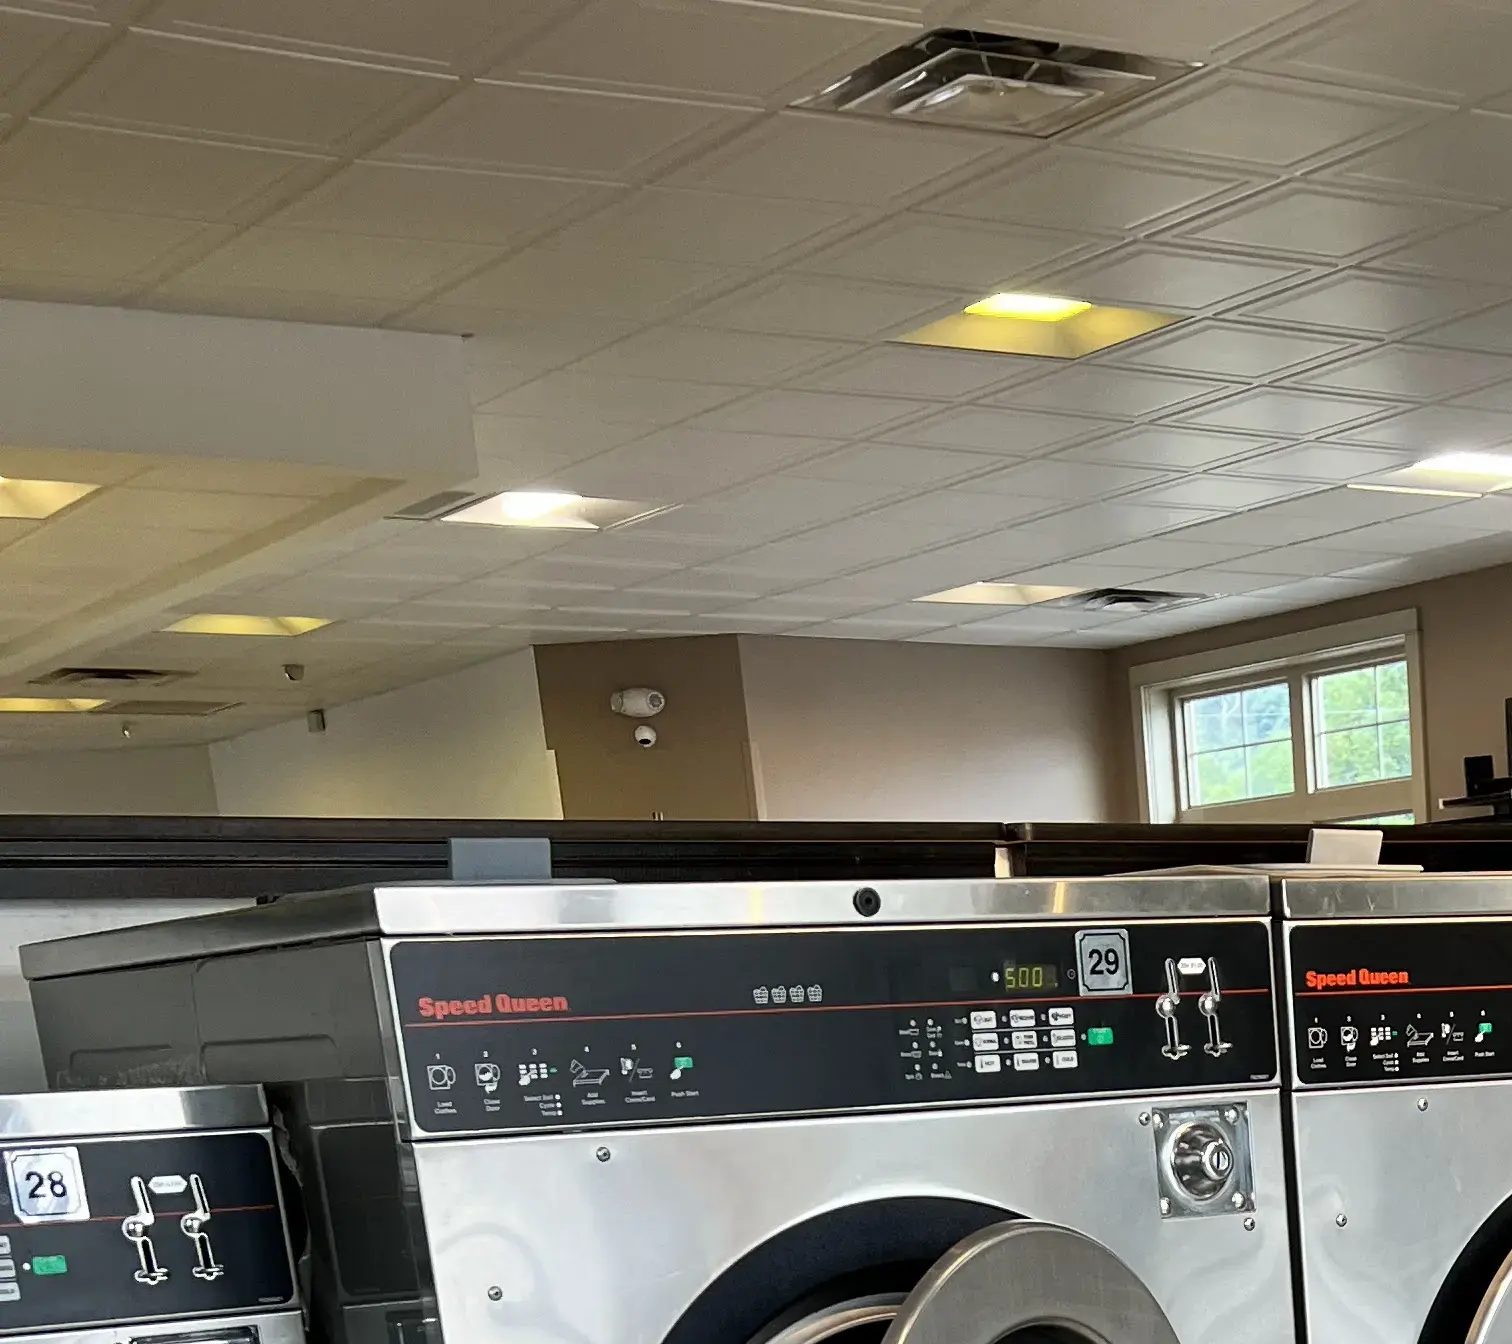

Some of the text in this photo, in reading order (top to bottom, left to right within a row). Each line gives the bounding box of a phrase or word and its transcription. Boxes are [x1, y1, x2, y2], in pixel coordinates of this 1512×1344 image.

[1087, 948, 1120, 976] 29
[1004, 967, 1044, 989] 500
[1305, 968, 1409, 990] Speed Queen
[418, 993, 569, 1020] Speed Queen
[25, 1169, 69, 1200] 28
